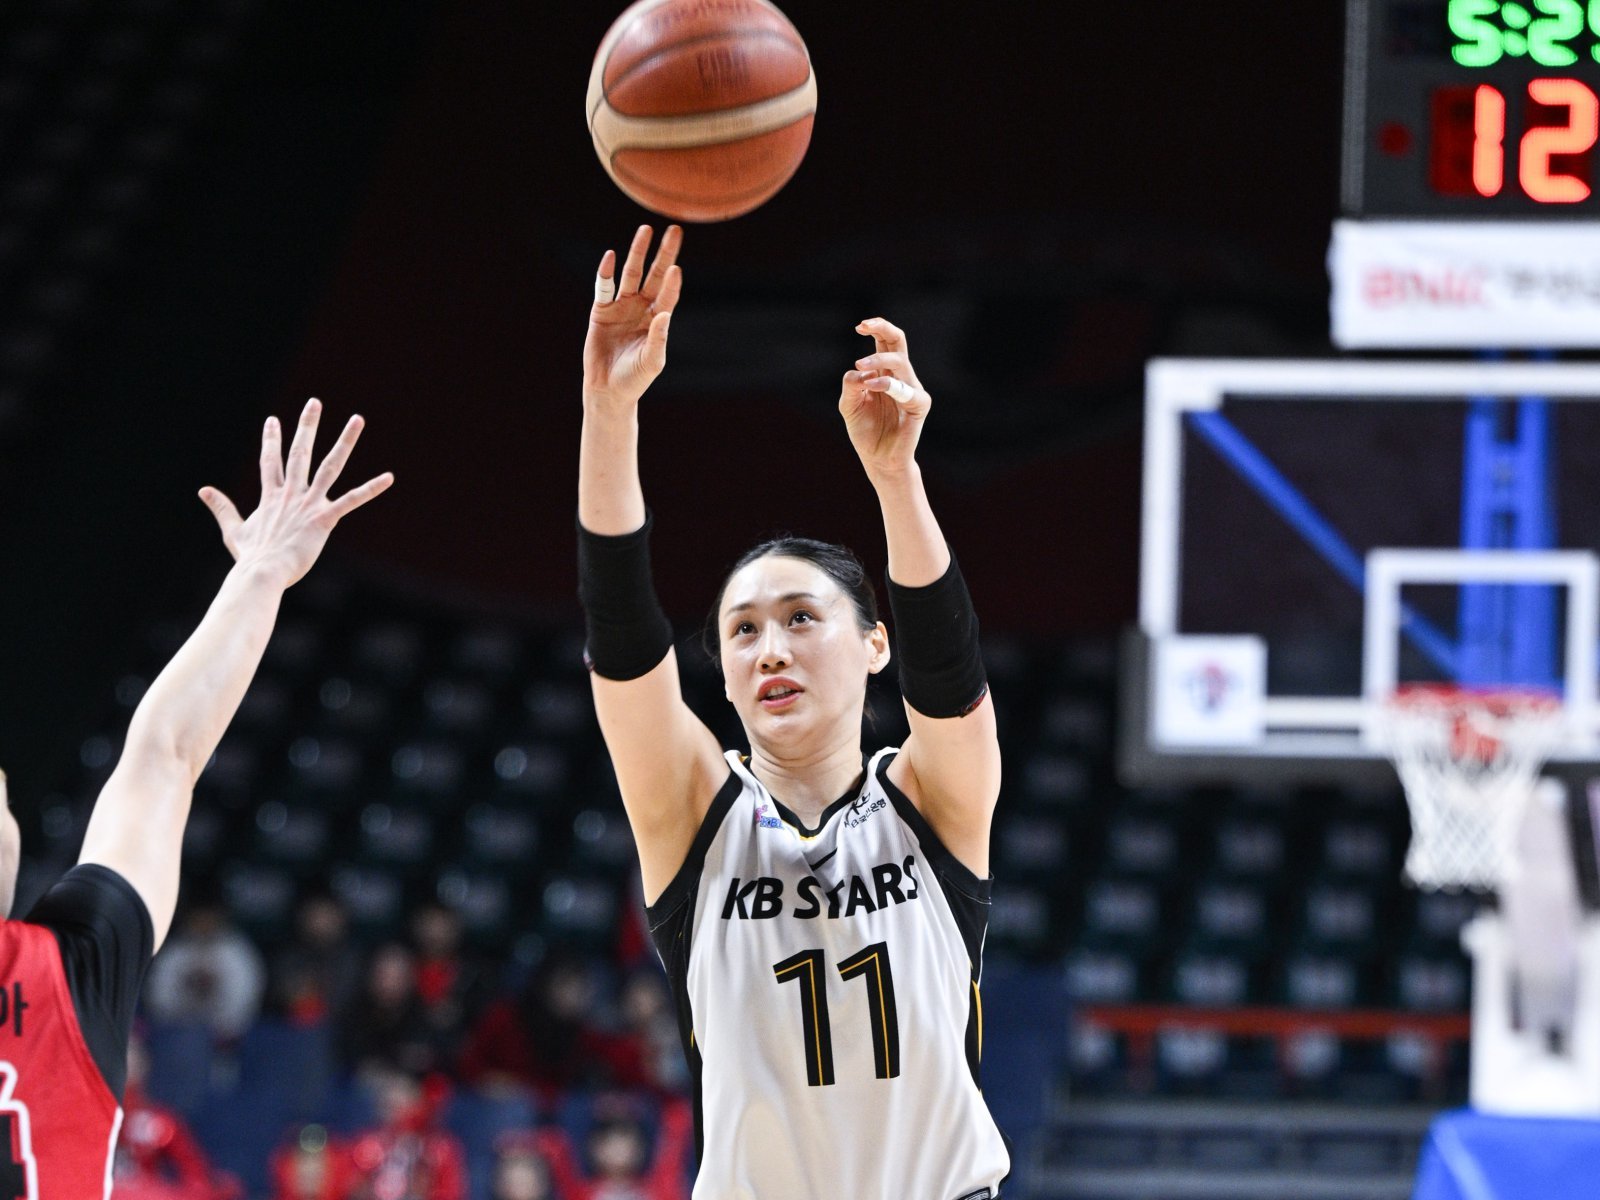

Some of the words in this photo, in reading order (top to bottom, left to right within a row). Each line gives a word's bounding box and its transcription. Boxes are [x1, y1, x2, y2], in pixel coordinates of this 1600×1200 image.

[1448, 0, 1600, 67] 5:2
[1472, 78, 1599, 204] 12
[720, 876, 784, 920] KB
[793, 855, 919, 920] STARS
[773, 940, 901, 1087] 11
